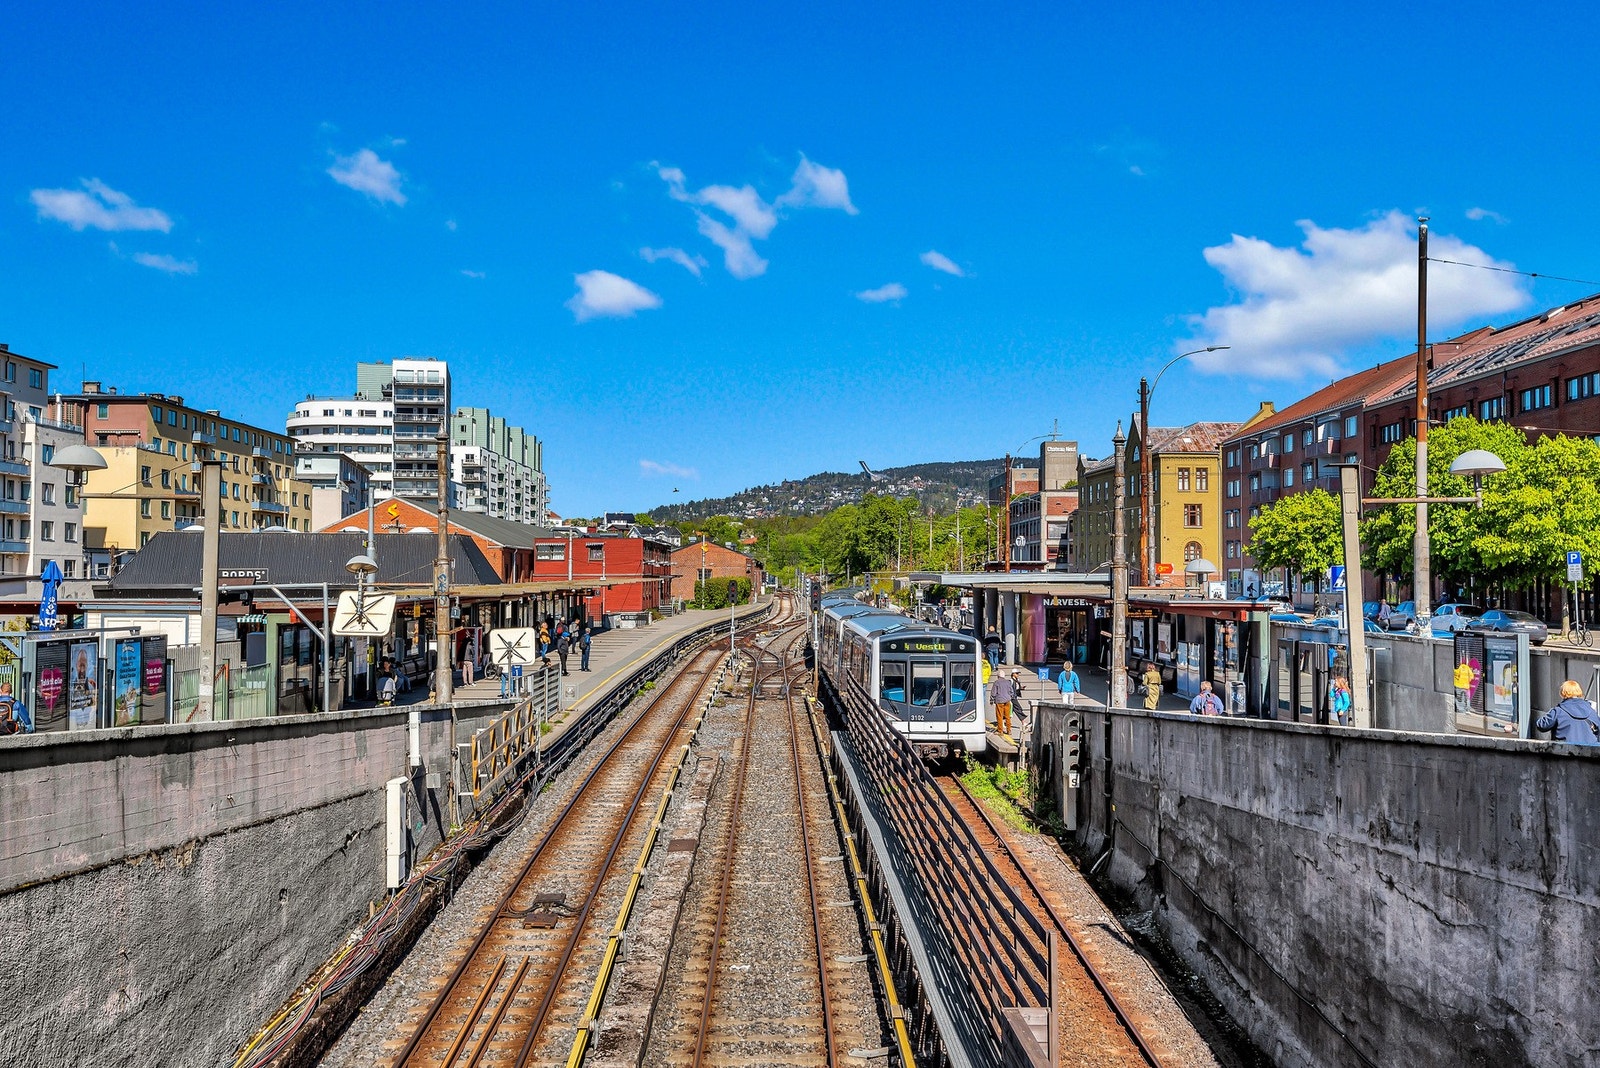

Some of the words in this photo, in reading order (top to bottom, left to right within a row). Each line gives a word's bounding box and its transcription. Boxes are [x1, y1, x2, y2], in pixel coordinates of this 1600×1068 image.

[1570, 553, 1578, 564] P
[904, 642, 910, 650] 4
[915, 643, 946, 651] Vestli
[1071, 778, 1078, 787] S
